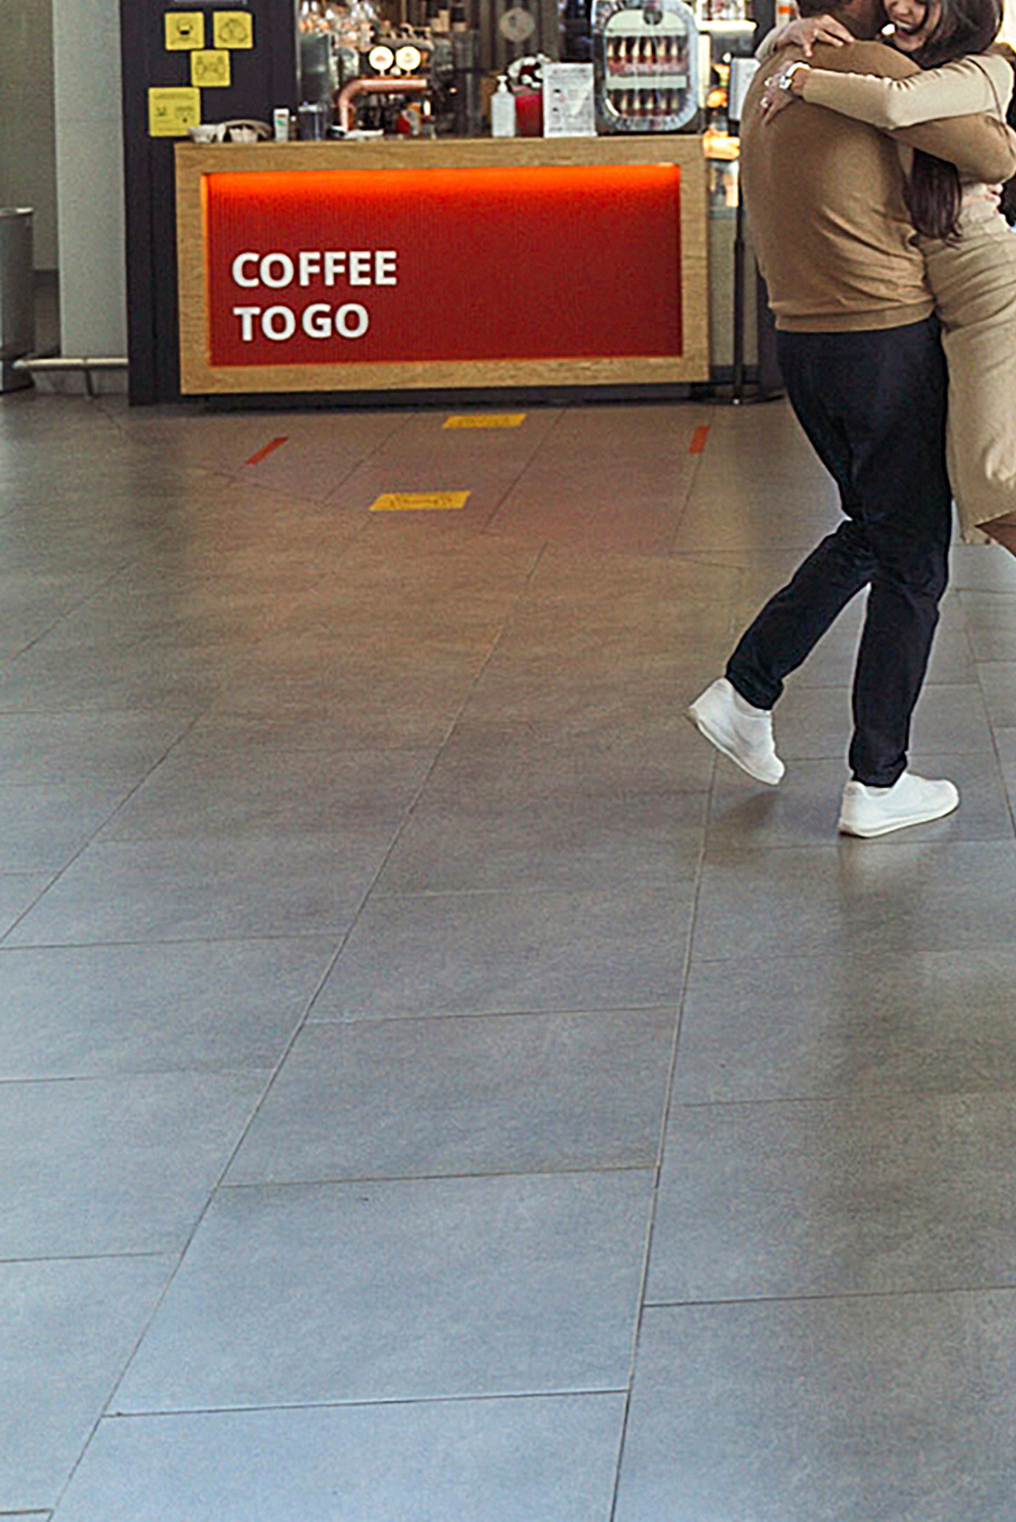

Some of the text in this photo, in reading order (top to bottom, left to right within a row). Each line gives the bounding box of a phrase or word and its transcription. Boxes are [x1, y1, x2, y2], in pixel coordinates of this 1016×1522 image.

[232, 250, 398, 289] COFFEE
[232, 303, 370, 342] TO GO
